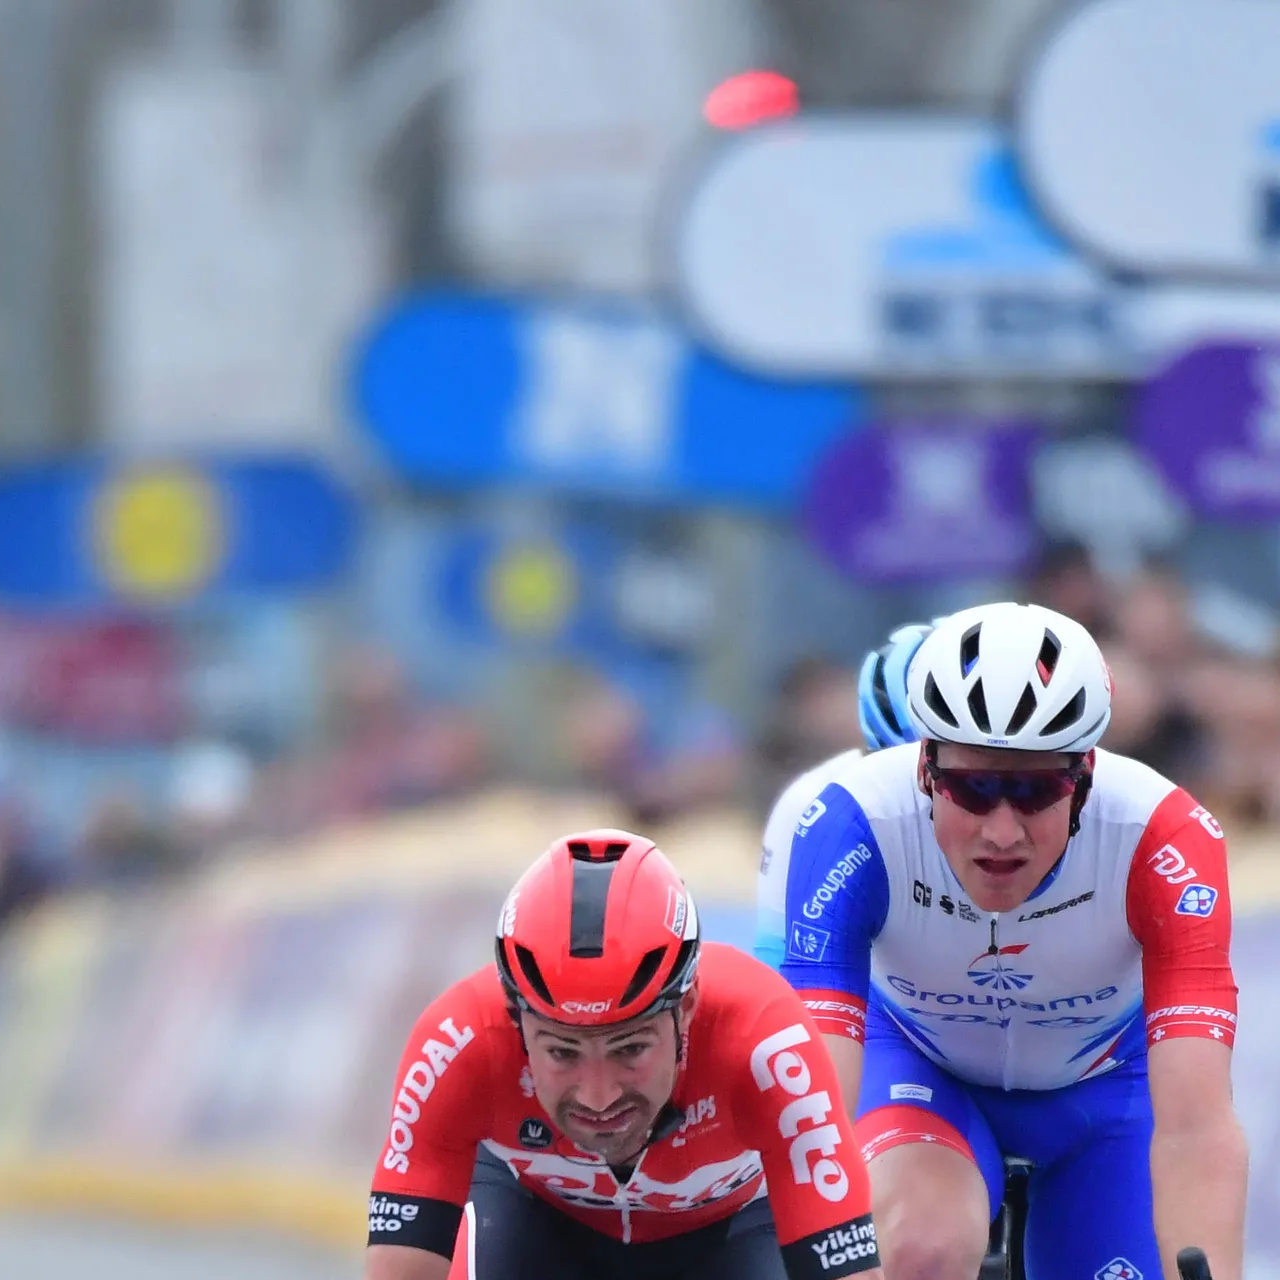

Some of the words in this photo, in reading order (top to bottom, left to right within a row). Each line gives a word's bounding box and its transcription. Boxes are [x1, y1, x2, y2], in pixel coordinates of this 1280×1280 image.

[1147, 844, 1198, 885] FDJ
[803, 843, 872, 920] Groupama
[1018, 890, 1095, 923] LAPIERRE
[886, 974, 1118, 1012] Groupama
[384, 1017, 475, 1174] SOUDAL
[369, 1218, 402, 1232] tto
[370, 1197, 419, 1221] king
[812, 1222, 876, 1255] viking
[819, 1241, 876, 1270] lotto
